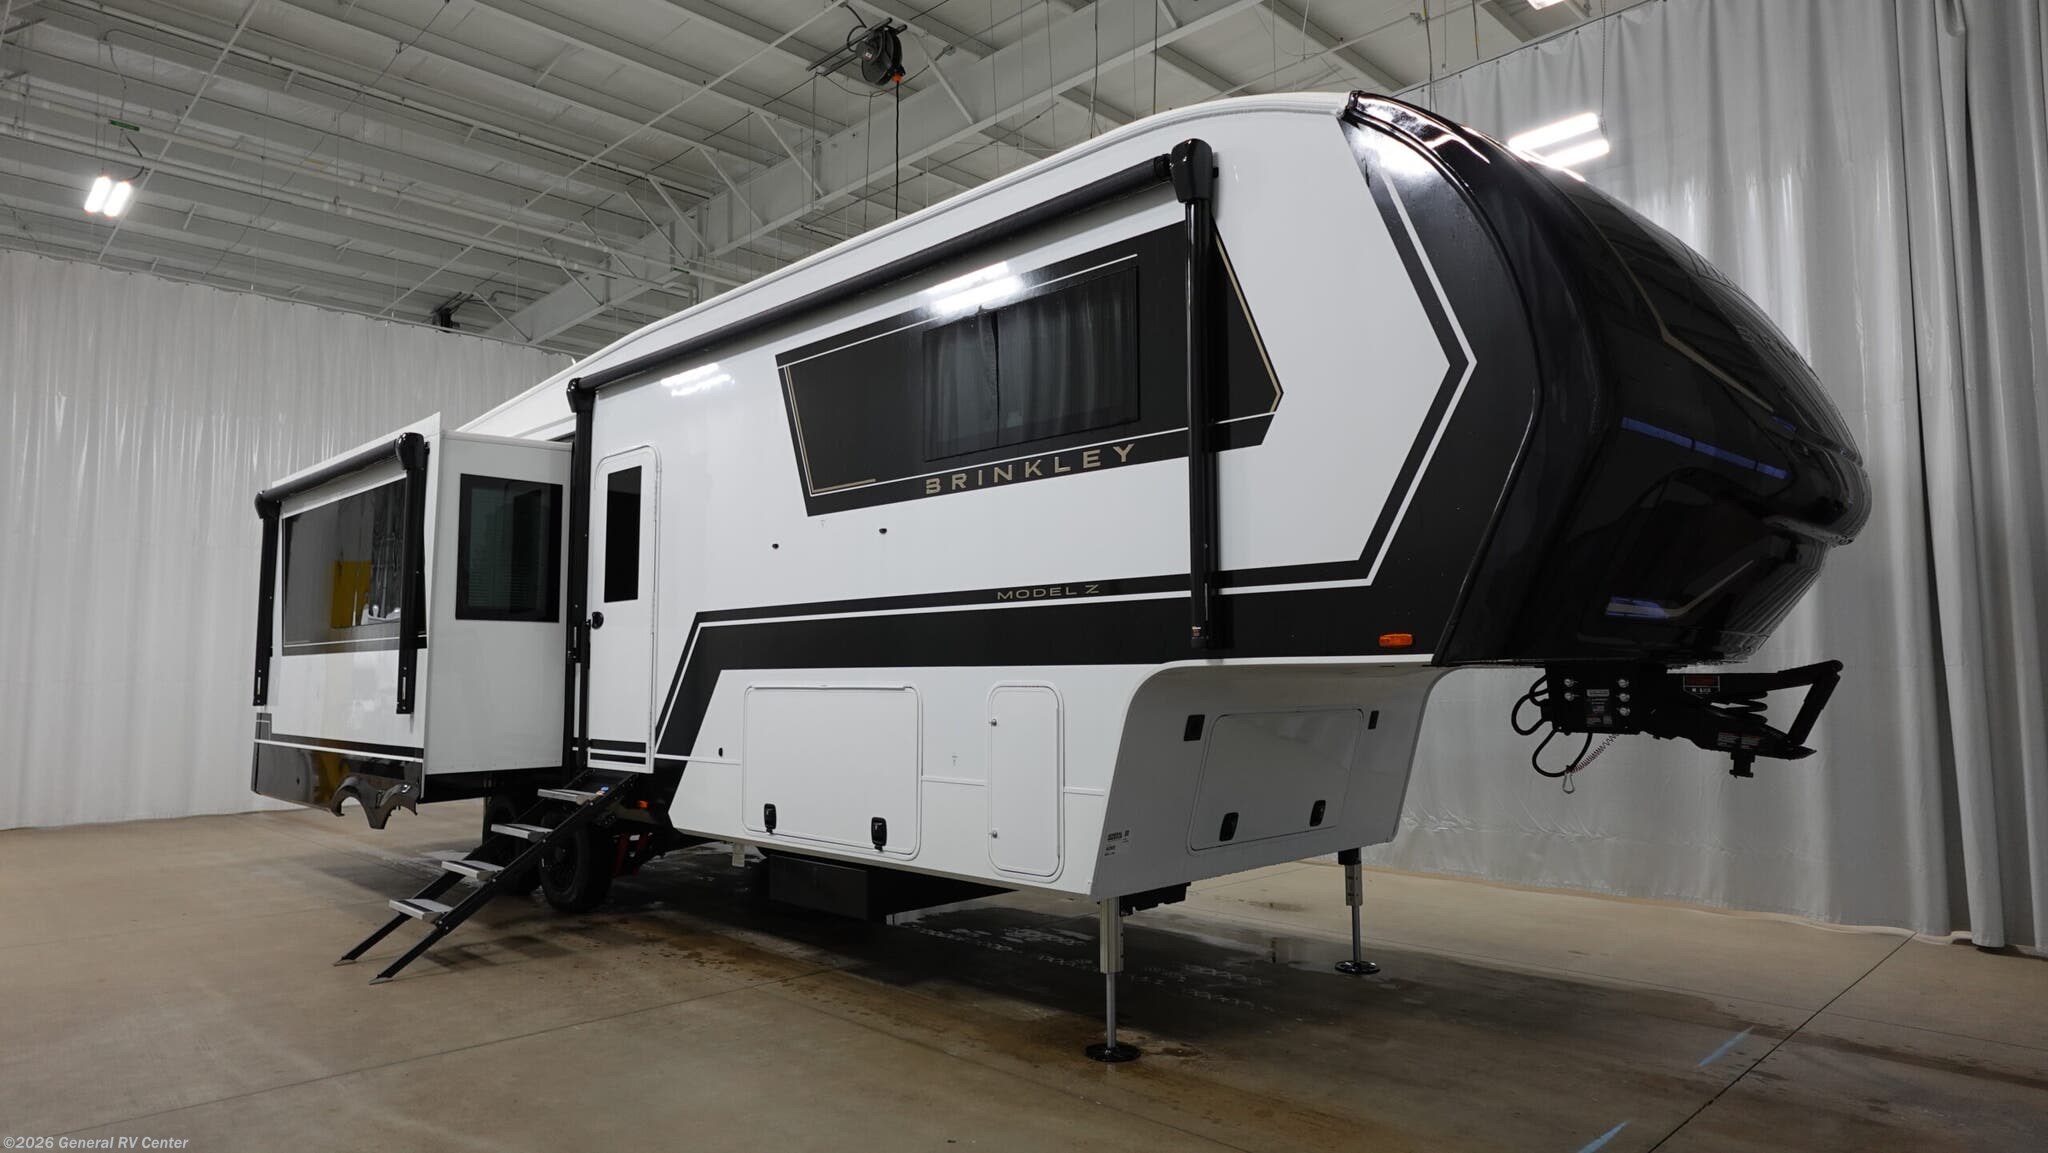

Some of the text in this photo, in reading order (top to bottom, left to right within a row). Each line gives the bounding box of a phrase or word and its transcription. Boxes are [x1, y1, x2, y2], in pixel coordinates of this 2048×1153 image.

[925, 443, 1136, 495] BRINKLEY
[997, 584, 1100, 601] MODEL Z
